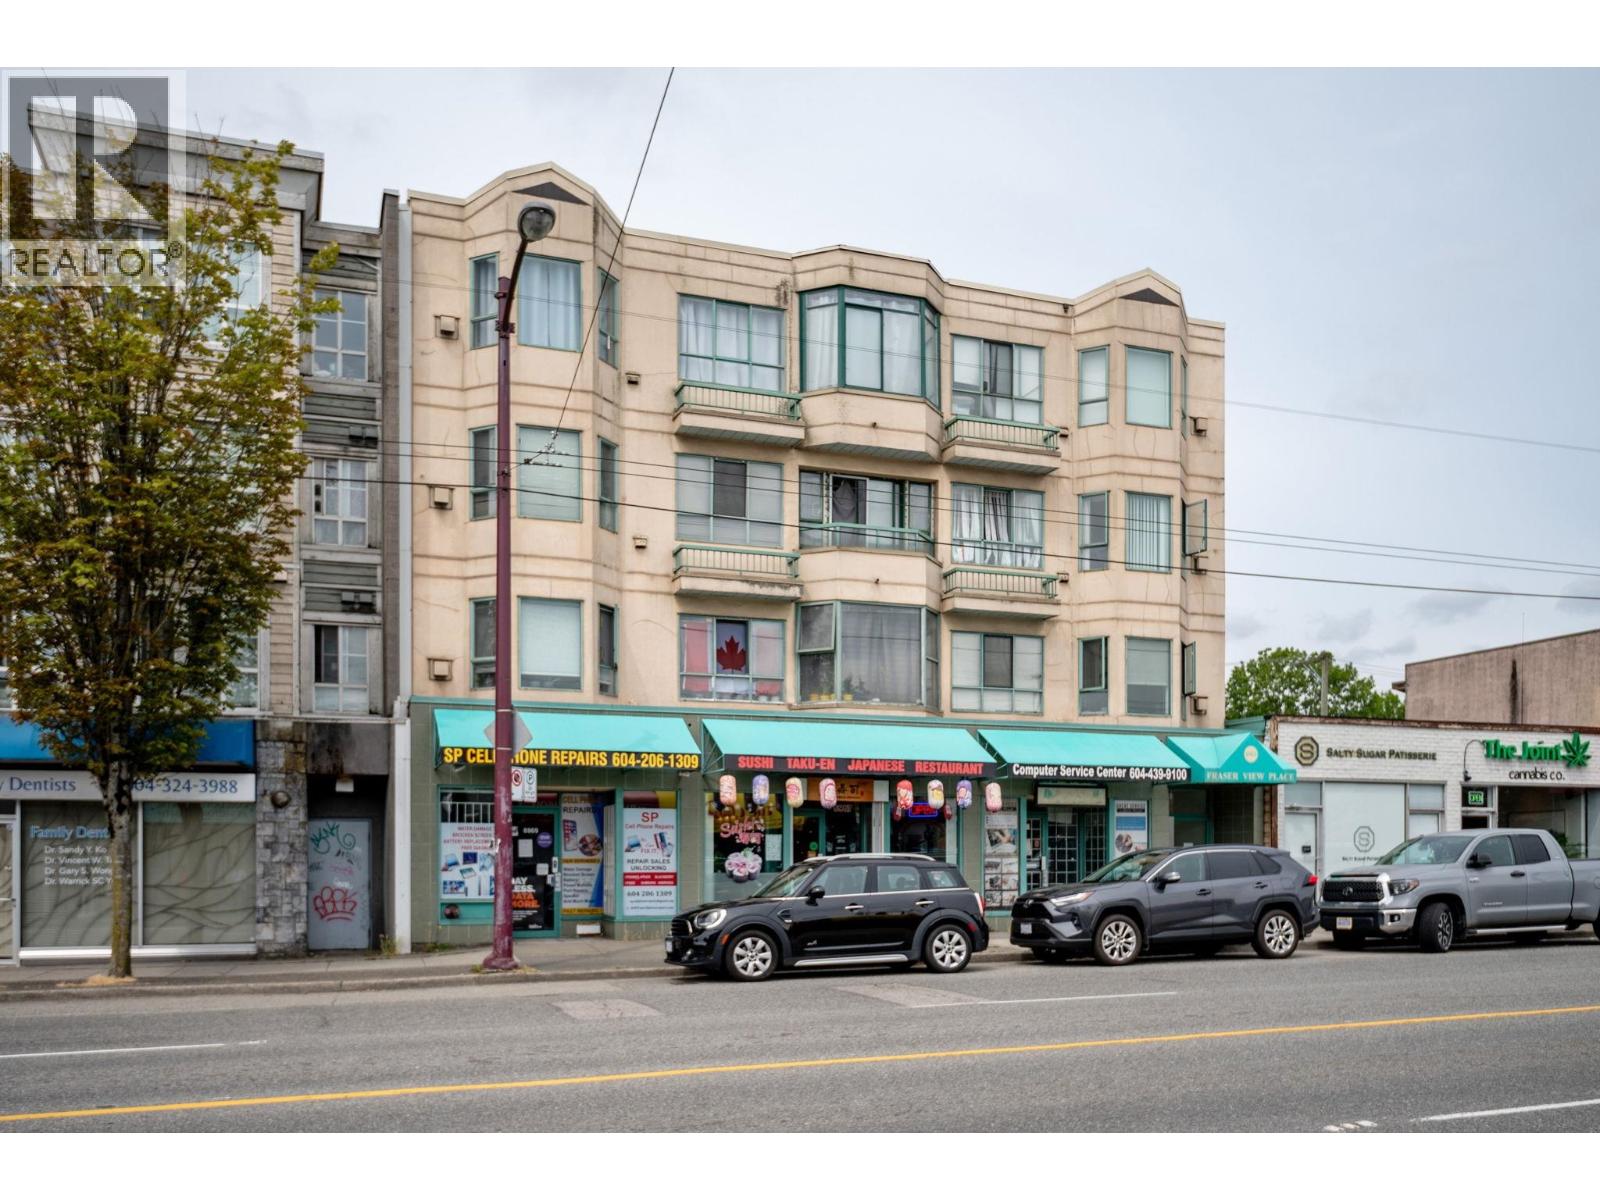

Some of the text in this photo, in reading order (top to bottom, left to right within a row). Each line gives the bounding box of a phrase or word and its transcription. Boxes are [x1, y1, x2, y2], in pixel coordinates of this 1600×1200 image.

[1326, 747, 1437, 760] SALTY SUGAR PATISSERIE
[1483, 739, 1563, 761] The Joint
[443, 747, 463, 764] SP
[511, 749, 548, 765] HONE
[550, 750, 608, 767] REPAIRS
[611, 751, 699, 769] 604-206-1309
[738, 755, 984, 775] SUSHI TAKU-EN JAPANESE RESTAURANT
[1012, 763, 1188, 781] Computer Service Center 604-439-9100
[1206, 771, 1295, 781] FRASER VIEW PLACE
[1508, 766, 1566, 781] cannabis co.
[9, 777, 77, 792] Dentists
[131, 778, 238, 793] 04-324-3988
[640, 811, 660, 823] SP
[29, 825, 110, 841] Family Dent
[58, 845, 85, 855] Sandy
[511, 877, 529, 885] AY
